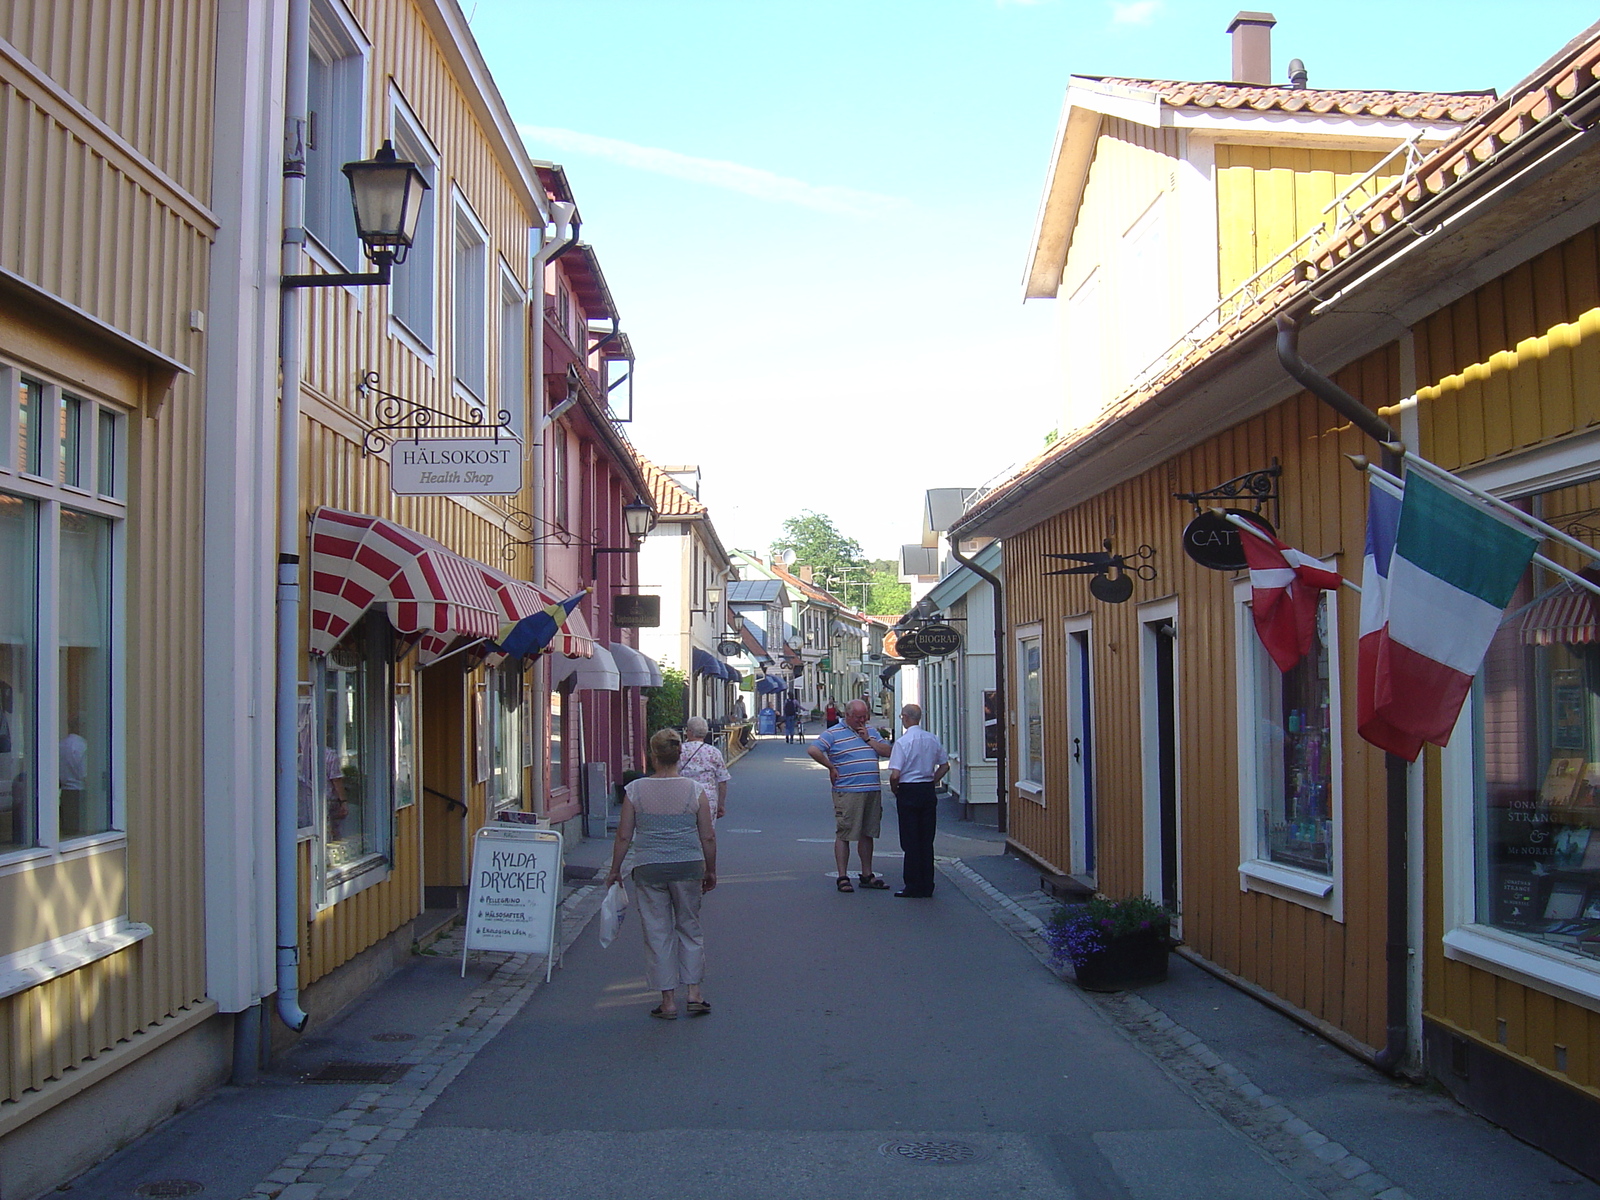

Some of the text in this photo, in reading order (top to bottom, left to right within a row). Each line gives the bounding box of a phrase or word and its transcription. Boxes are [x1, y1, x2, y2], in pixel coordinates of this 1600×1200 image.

[403, 448, 511, 465] HÄLSOKOST
[419, 471, 494, 486] Health Shop
[918, 634, 958, 644] BIOGRAF
[1507, 800, 1538, 810] JONA
[1521, 847, 1555, 856] NORRE
[492, 851, 537, 871] KYLDA
[480, 871, 547, 894] DRYCKER
[485, 896, 521, 904] PELLEGRINO
